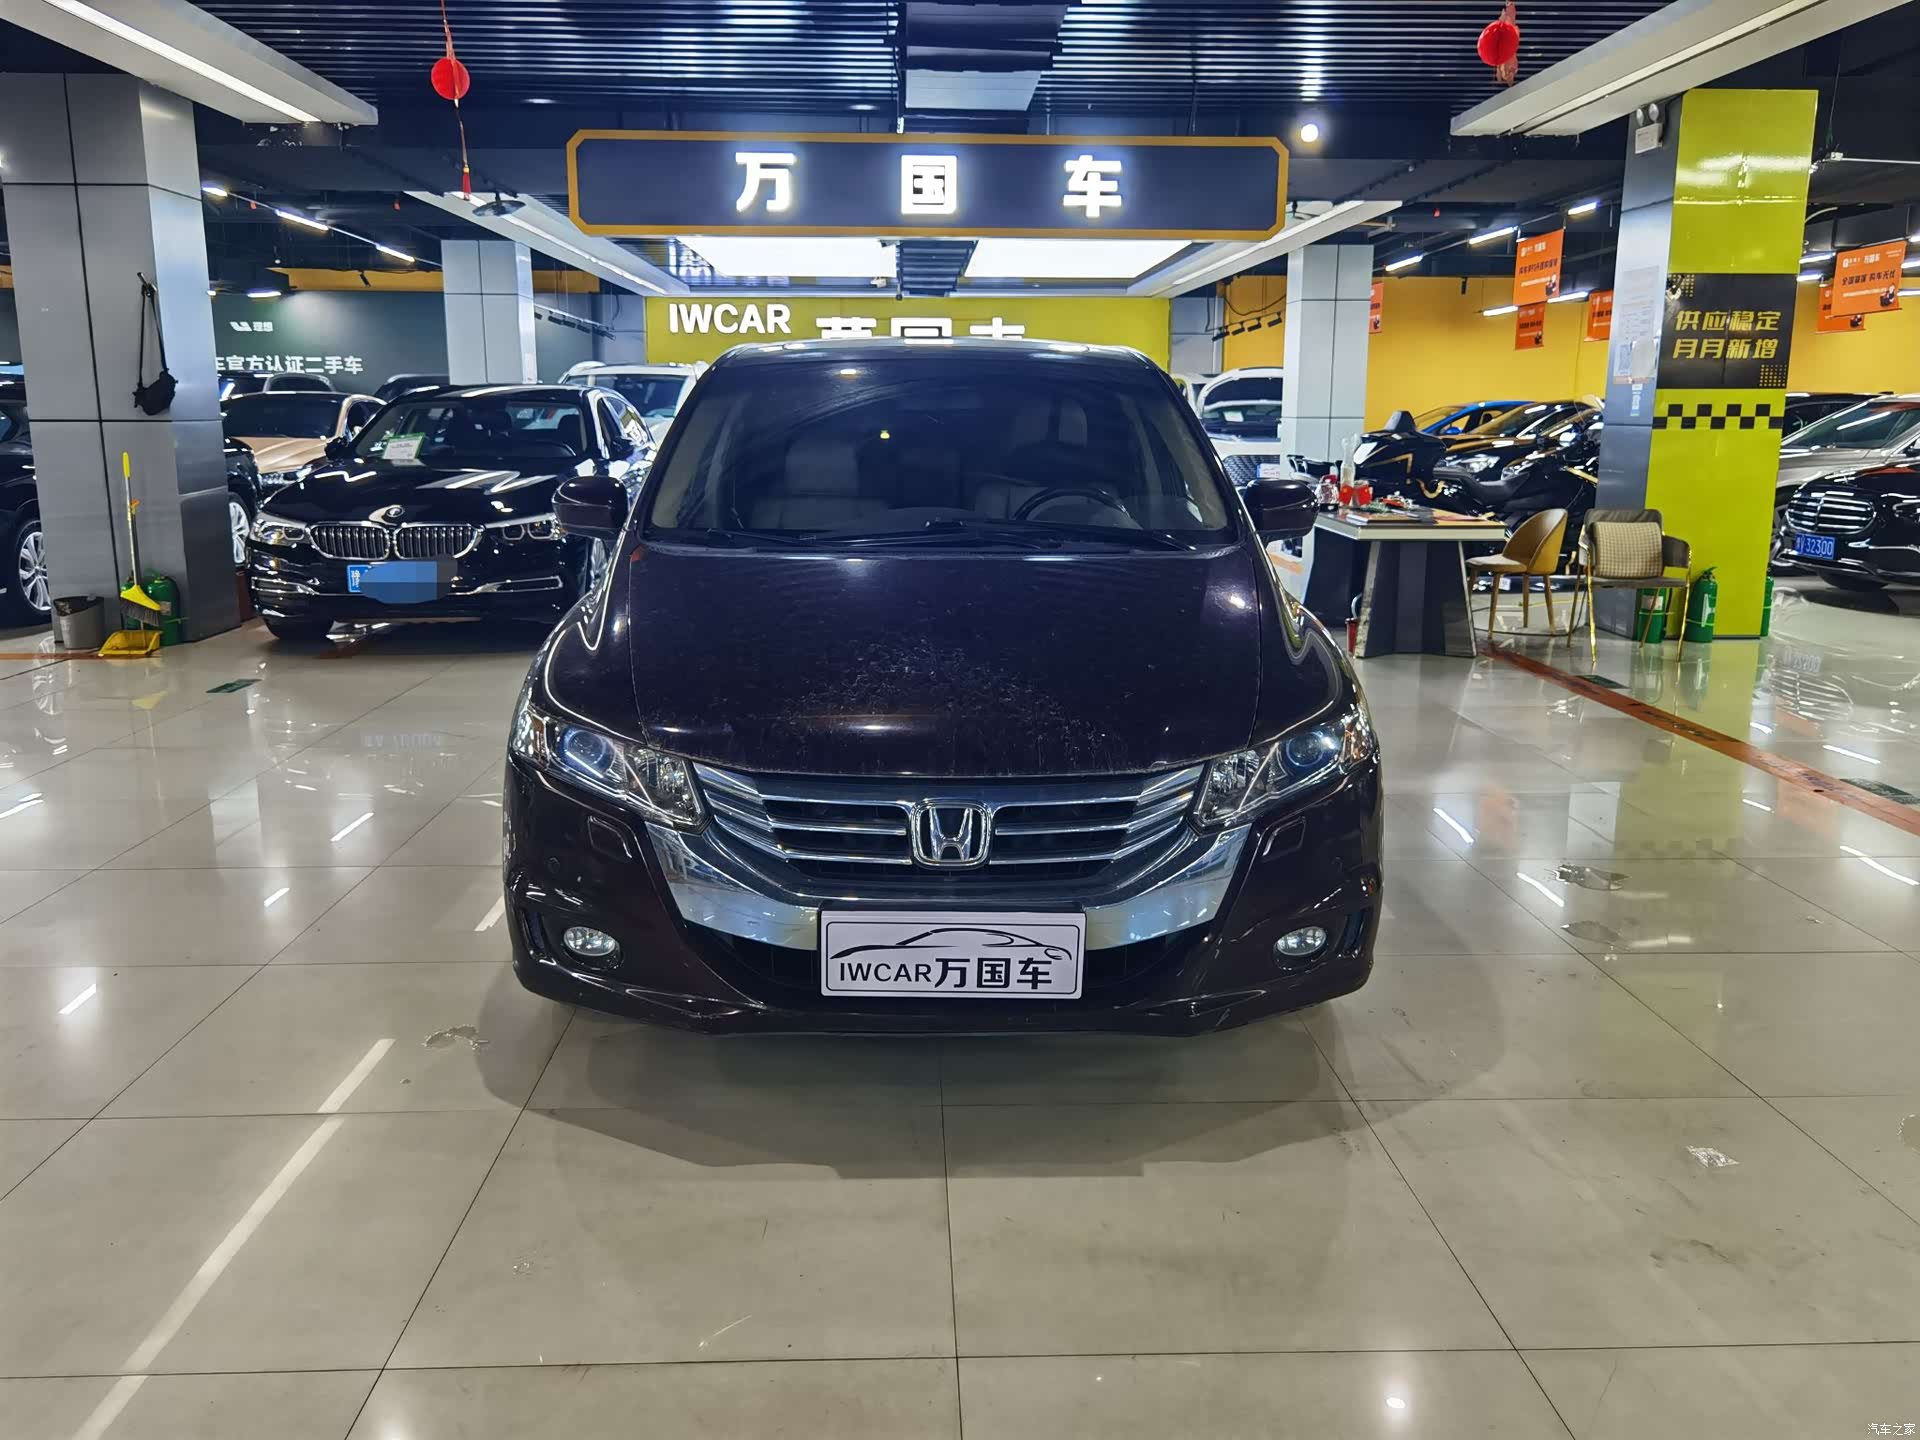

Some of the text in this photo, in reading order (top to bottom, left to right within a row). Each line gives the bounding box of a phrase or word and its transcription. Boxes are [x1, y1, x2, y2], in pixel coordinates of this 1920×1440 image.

[736, 152, 1122, 218] 万国车
[668, 303, 792, 334] IWCAR
[1675, 310, 1782, 332] 供应稳定
[1672, 338, 1779, 359] 月月新增
